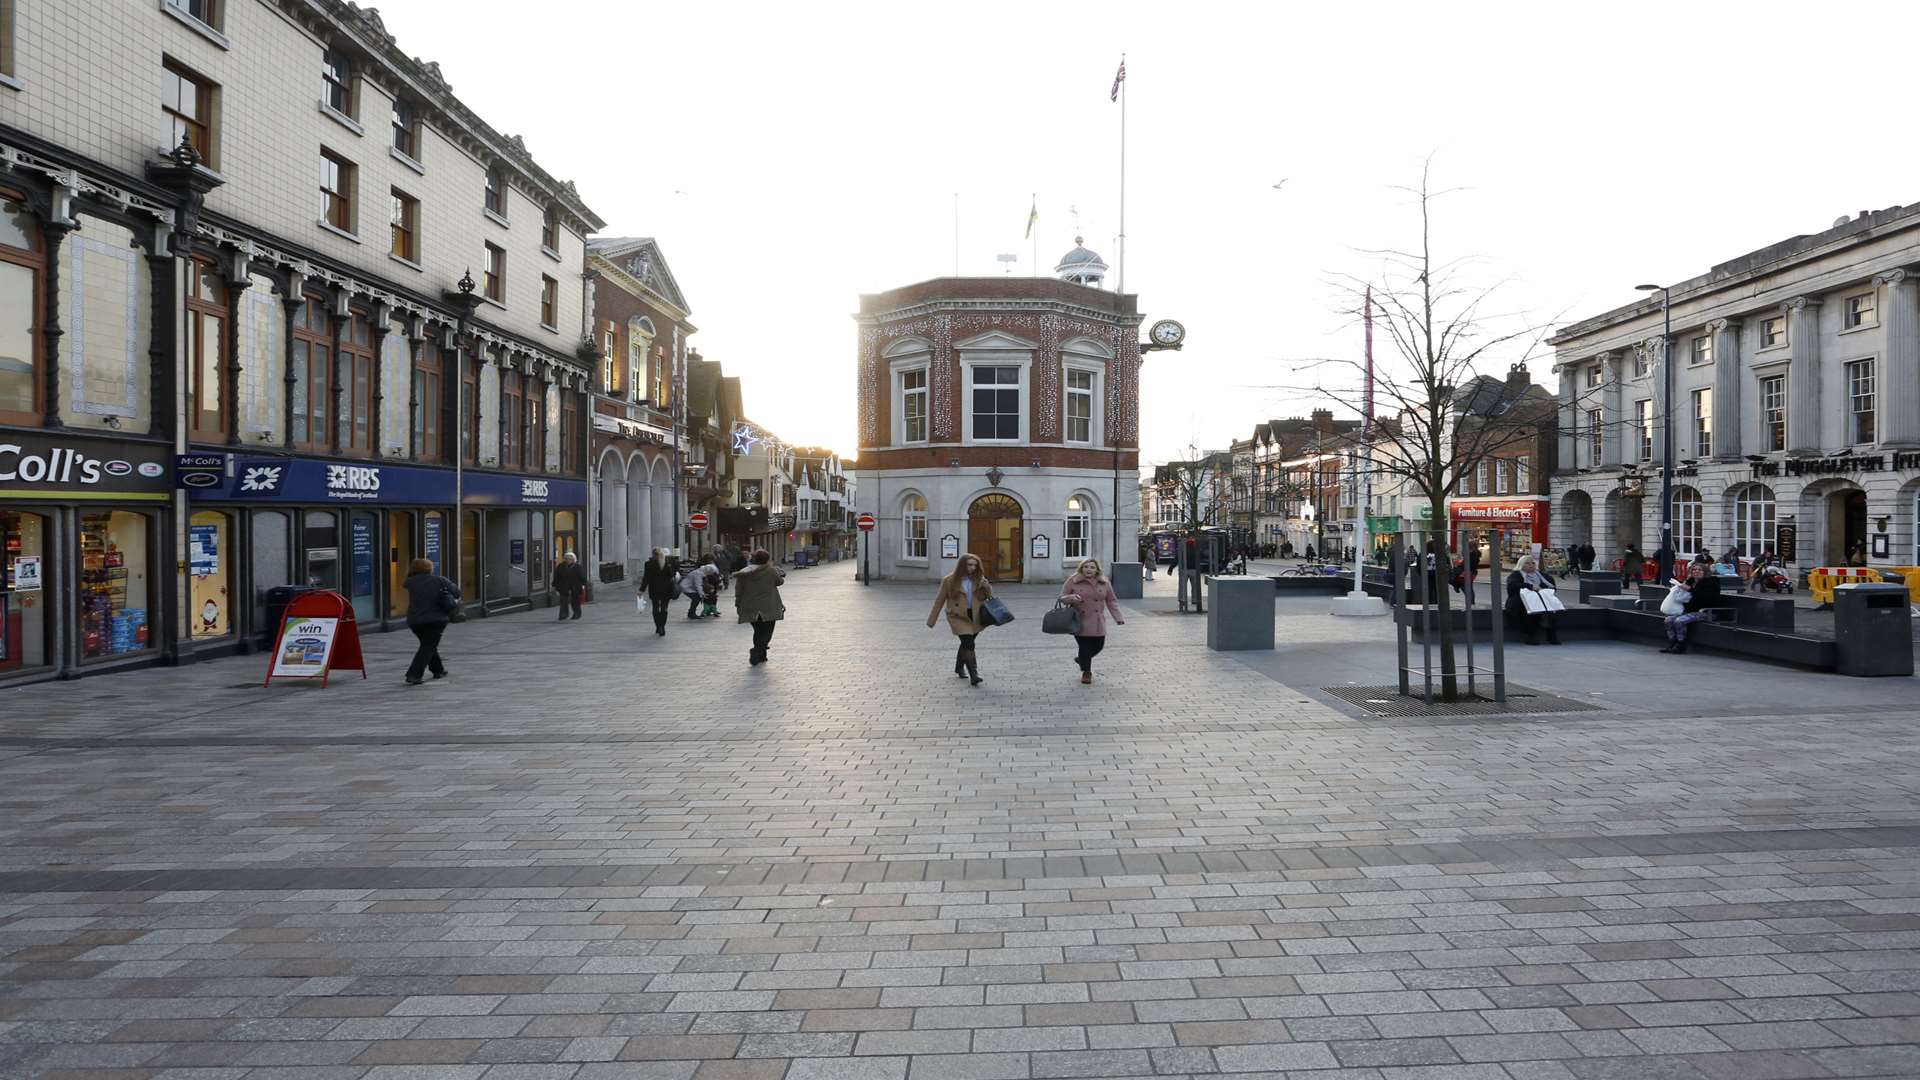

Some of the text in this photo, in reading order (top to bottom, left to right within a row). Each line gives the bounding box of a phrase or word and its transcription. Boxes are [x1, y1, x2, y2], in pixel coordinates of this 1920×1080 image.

[349, 467, 380, 490] RBS
[532, 480, 549, 497] RBS
[1458, 507, 1486, 517] Furniture
[1487, 507, 1492, 517] &
[298, 624, 322, 633] win
